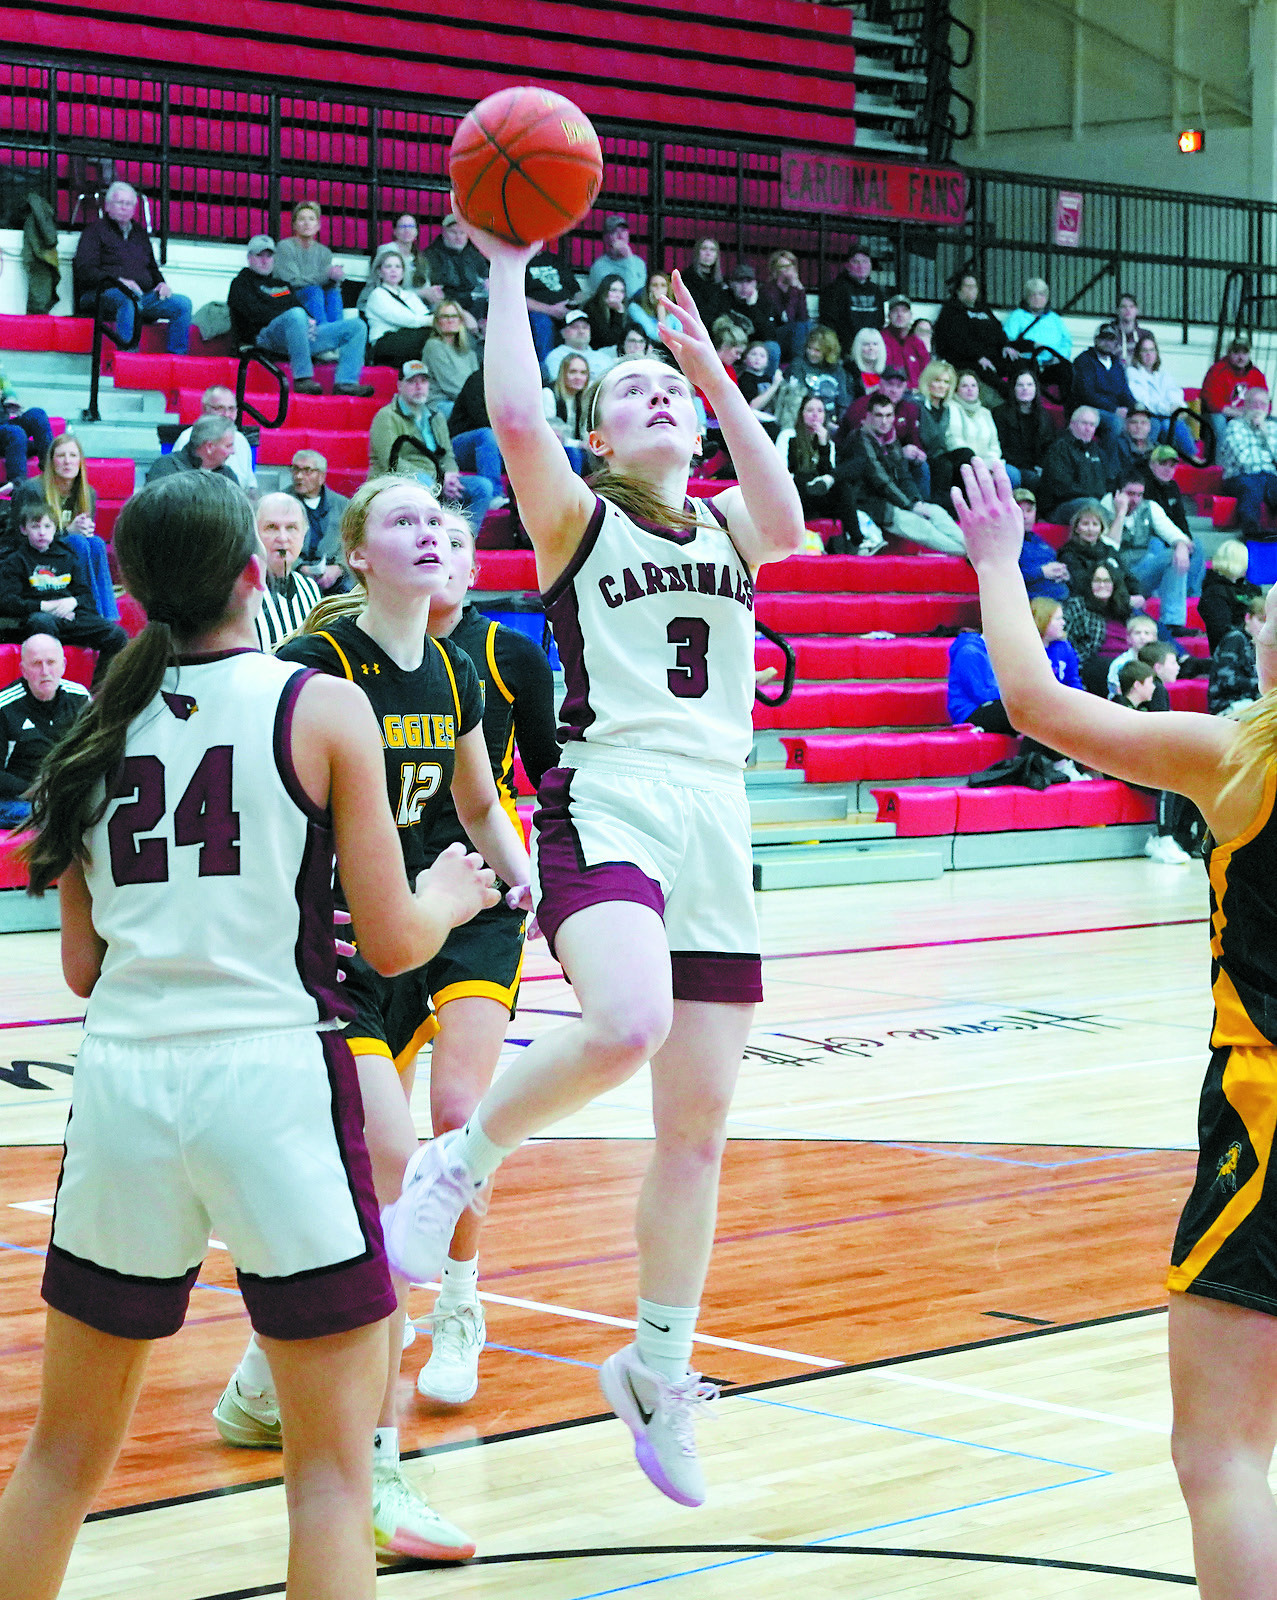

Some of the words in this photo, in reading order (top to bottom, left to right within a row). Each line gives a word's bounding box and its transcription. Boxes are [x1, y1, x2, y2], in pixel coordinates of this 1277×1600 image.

[786, 158, 894, 211] CARDINAL
[908, 172, 962, 218] FANS
[598, 561, 754, 612] CARDINALS
[666, 616, 711, 699] 3
[382, 713, 456, 750] GGIES
[106, 744, 241, 888] 24
[395, 761, 444, 828] 12
[886, 797, 896, 812] A
[742, 1045, 825, 1067] th
